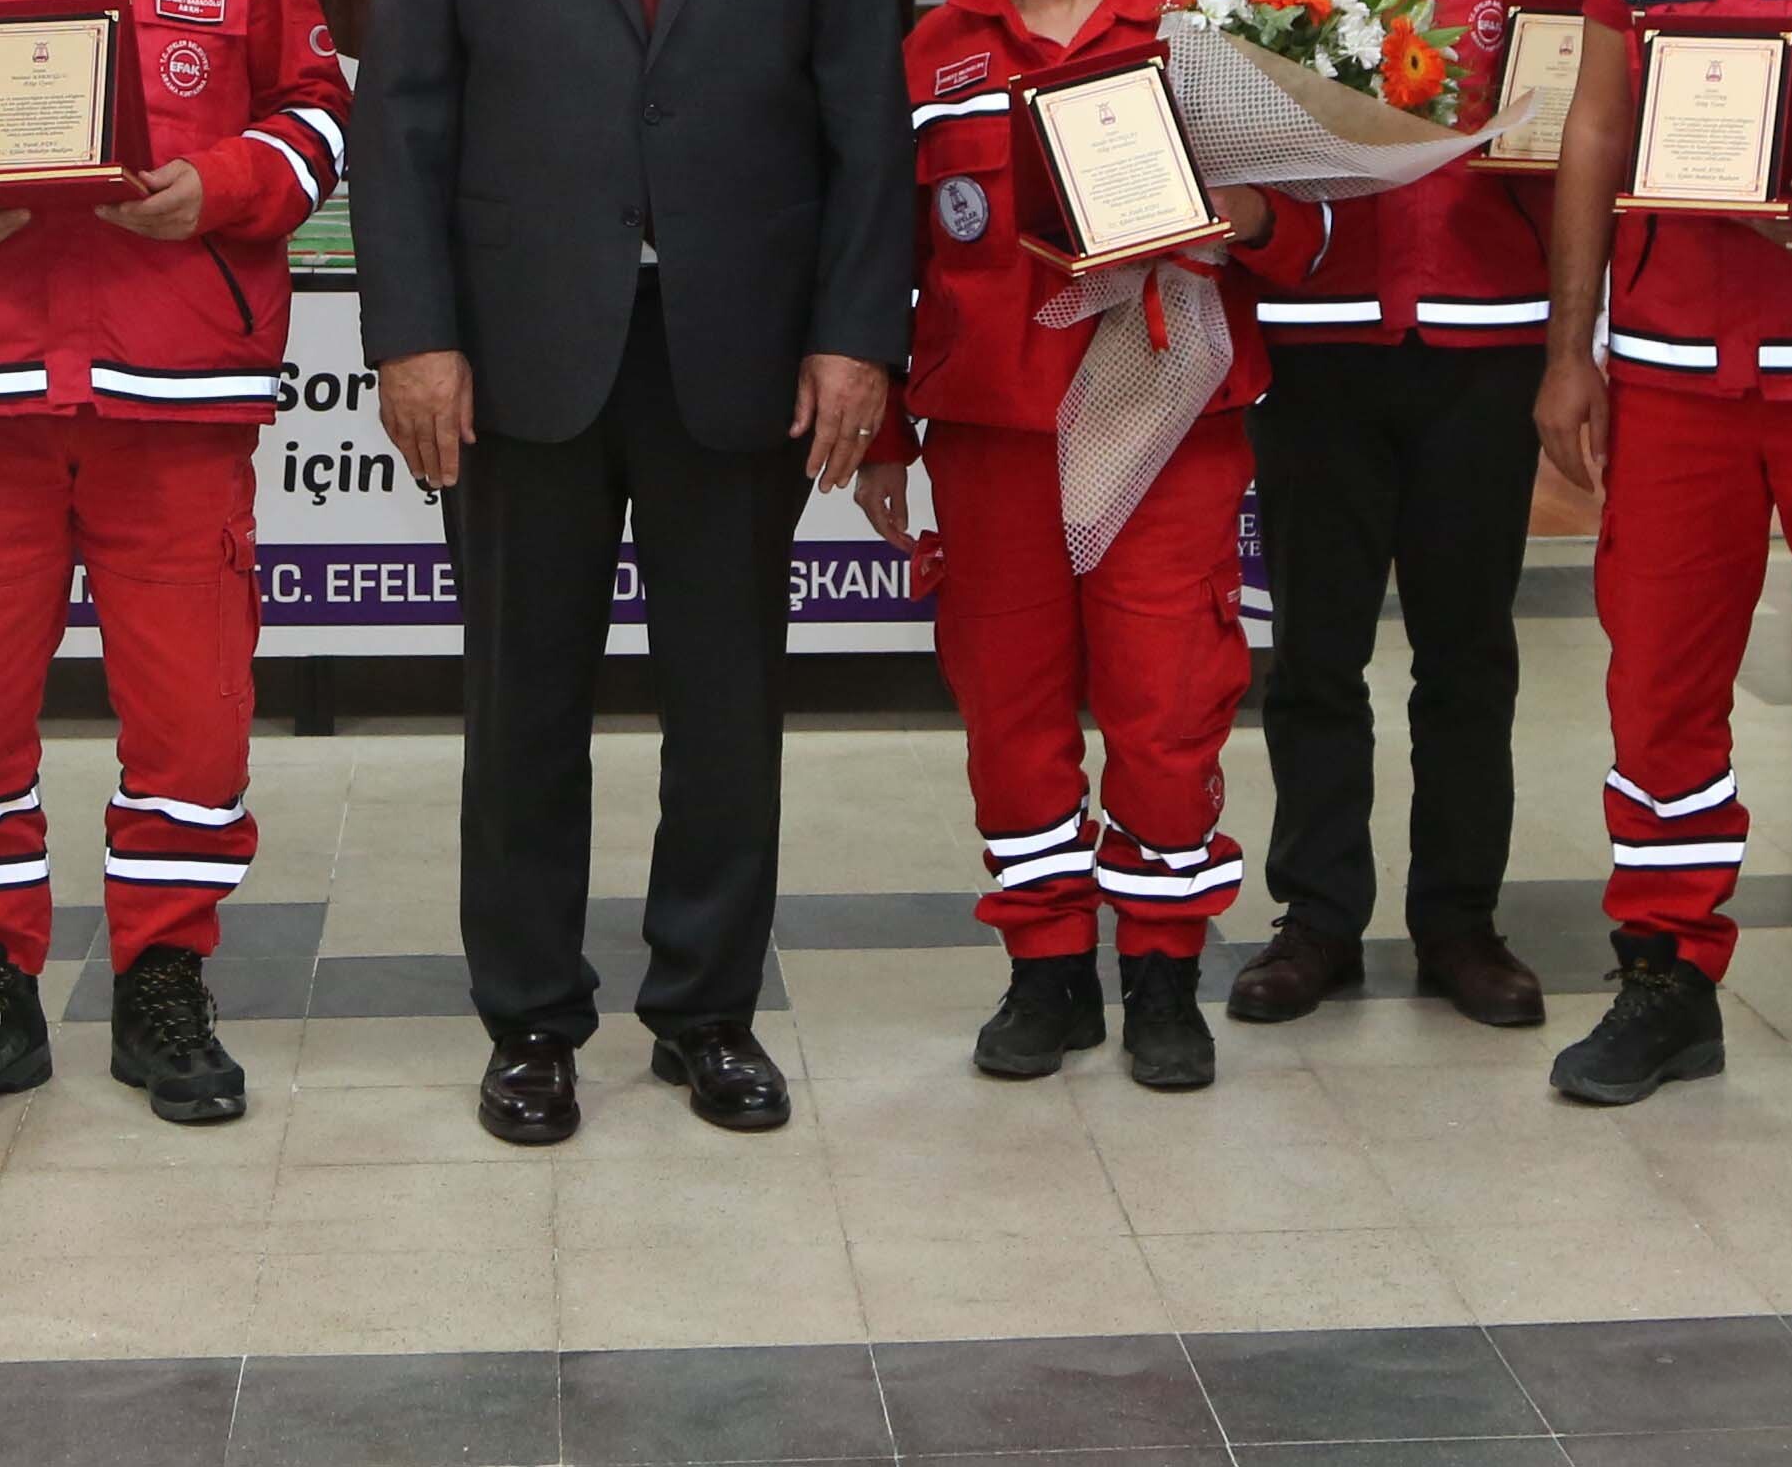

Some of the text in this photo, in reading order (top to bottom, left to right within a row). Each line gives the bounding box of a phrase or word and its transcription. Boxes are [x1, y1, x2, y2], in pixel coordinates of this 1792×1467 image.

[170, 61, 200, 76] EFAK
[276, 361, 378, 413] Sor
[282, 440, 395, 506] için
[259, 563, 313, 604] .C.
[326, 563, 458, 603] EFELE
[789, 560, 911, 612] ŞKANI
